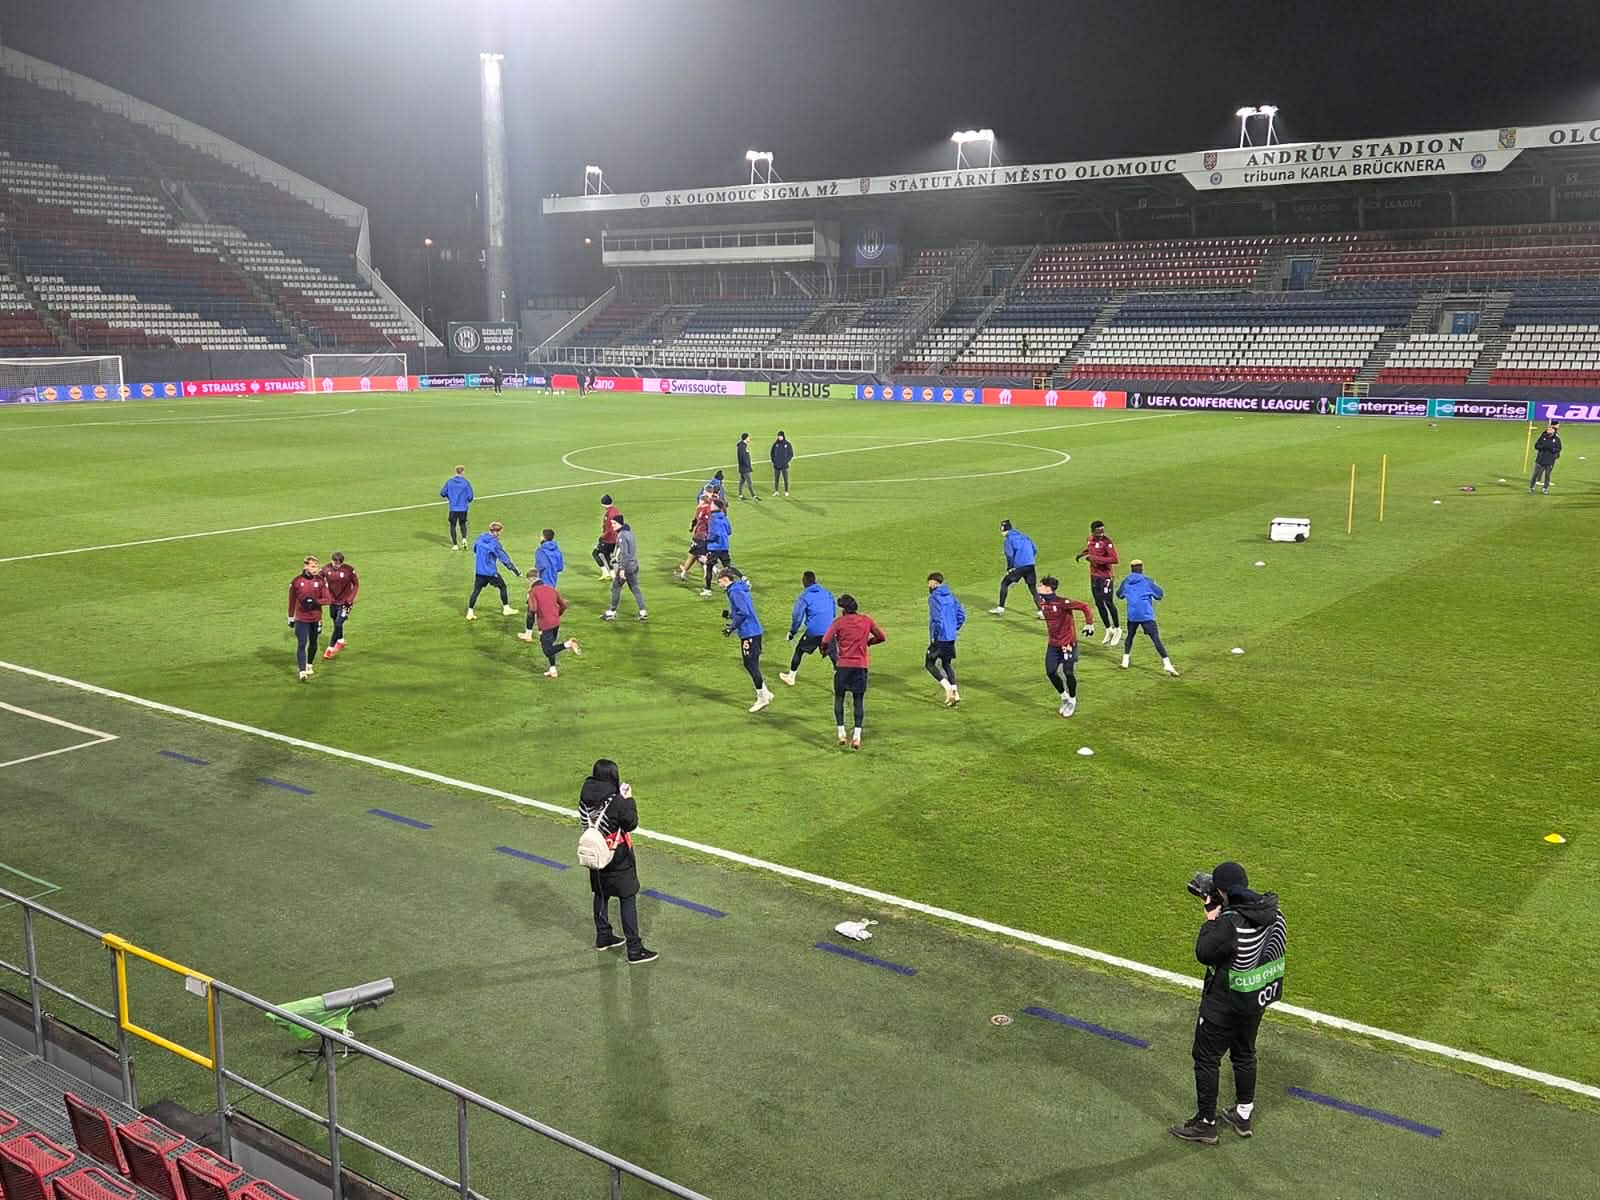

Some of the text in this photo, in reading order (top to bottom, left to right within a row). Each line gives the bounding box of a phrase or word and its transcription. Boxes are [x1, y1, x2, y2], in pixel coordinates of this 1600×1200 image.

[1245, 137, 1465, 166] ANDRŮV STADION
[889, 159, 1177, 192] STATUTÁRNÍ MĚSTO OLOMOUC
[1243, 159, 1446, 183] tribuna KARLA BRÜCKNERA
[665, 182, 839, 205] SK OLOMOUC SIGMA MŽ
[201, 381, 305, 393] STRAUSS STRAUSS
[421, 376, 465, 386] enterprise
[671, 380, 727, 393] Swissquote
[1147, 395, 1310, 410] UEFA CONFERENCE LEAGUE
[1346, 401, 1426, 414] enterprise
[1440, 403, 1526, 416] enterprise
[1235, 974, 1261, 986] CLUB
